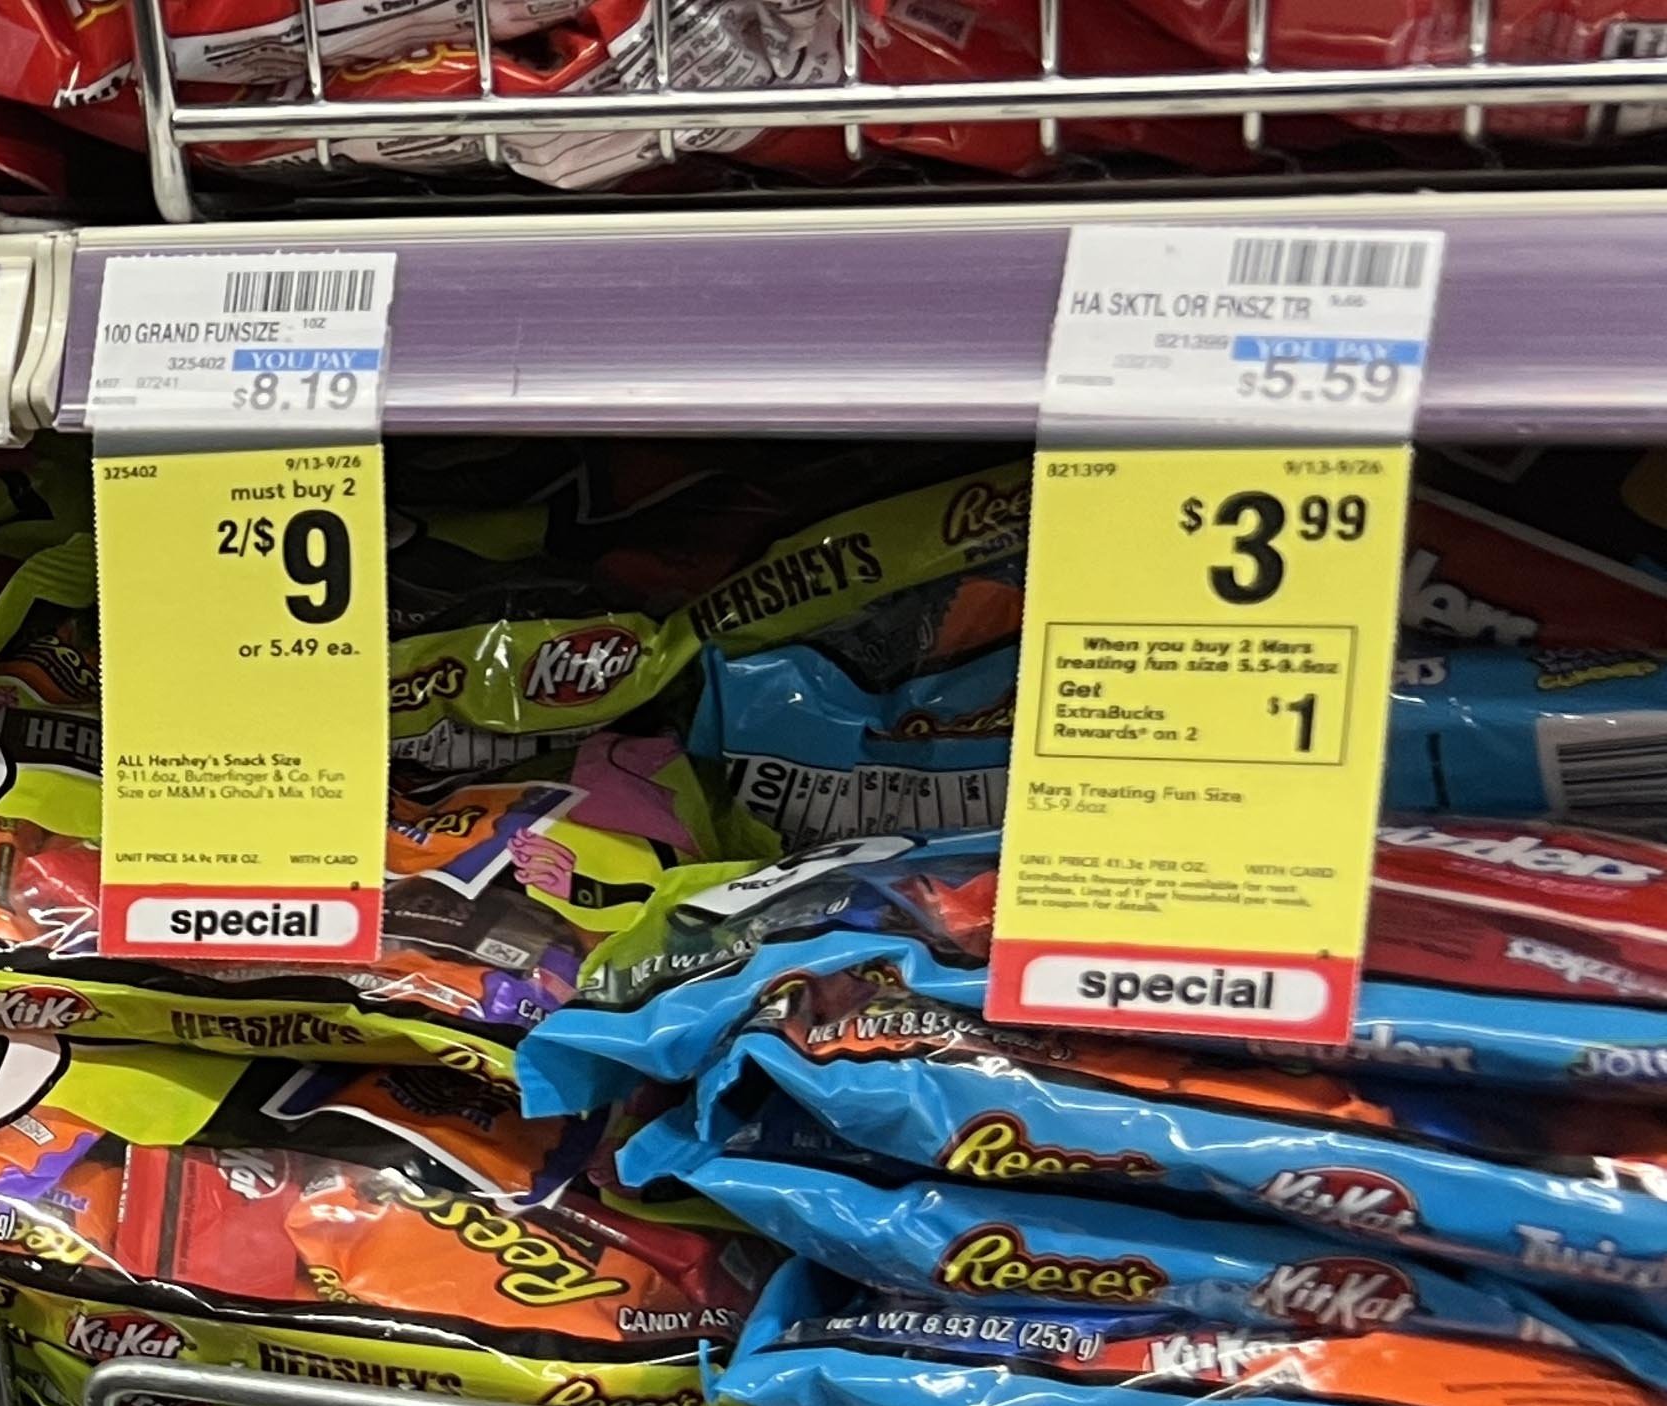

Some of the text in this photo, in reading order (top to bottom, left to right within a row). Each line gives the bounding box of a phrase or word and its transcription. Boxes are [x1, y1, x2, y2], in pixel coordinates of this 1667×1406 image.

[1070, 291, 1209, 319] HA SKTL OR
[104, 320, 281, 345] 100 GRAND FUNSIZE
[167, 350, 359, 371] 325402 YOU PAY
[232, 371, 359, 412] $8.19
[1236, 354, 1401, 404] $5.59
[103, 455, 362, 481] 325402 9/13-9/26
[1046, 462, 1118, 478] 821399
[230, 477, 357, 503] must buy 2
[688, 531, 883, 639] HERSHEY'S
[238, 638, 361, 658] or 5.49 ea.
[1082, 636, 1314, 657] When you buy Mars
[526, 627, 643, 697] KitKat
[1055, 655, 1230, 674] treating fun size
[1057, 679, 1103, 700] Get
[1055, 703, 1166, 722] ExtraBucks
[1152, 727, 1178, 742] on
[116, 753, 302, 770] ALL Hershey's Snack Size
[184, 769, 346, 786] Butterfinger Fun
[116, 785, 305, 800] Size M&M's Ghoul's Mix
[1027, 780, 1245, 804] Mars Treating Fun Size
[115, 852, 178, 864] UNIT PRICE
[323, 854, 359, 866] CARD
[169, 902, 320, 942] special
[1076, 966, 1275, 1011] special
[170, 1007, 365, 1049] HERSHEY'S
[806, 1017, 897, 1045] NET WT
[1263, 1171, 1417, 1231] KitKat
[946, 1234, 1157, 1301] Reese's
[1261, 1265, 1417, 1328] KitKat
[617, 1305, 693, 1335] CANDY
[877, 1311, 1068, 1355] WT 8.93 OZ (253
[67, 1313, 185, 1360] KitKat
